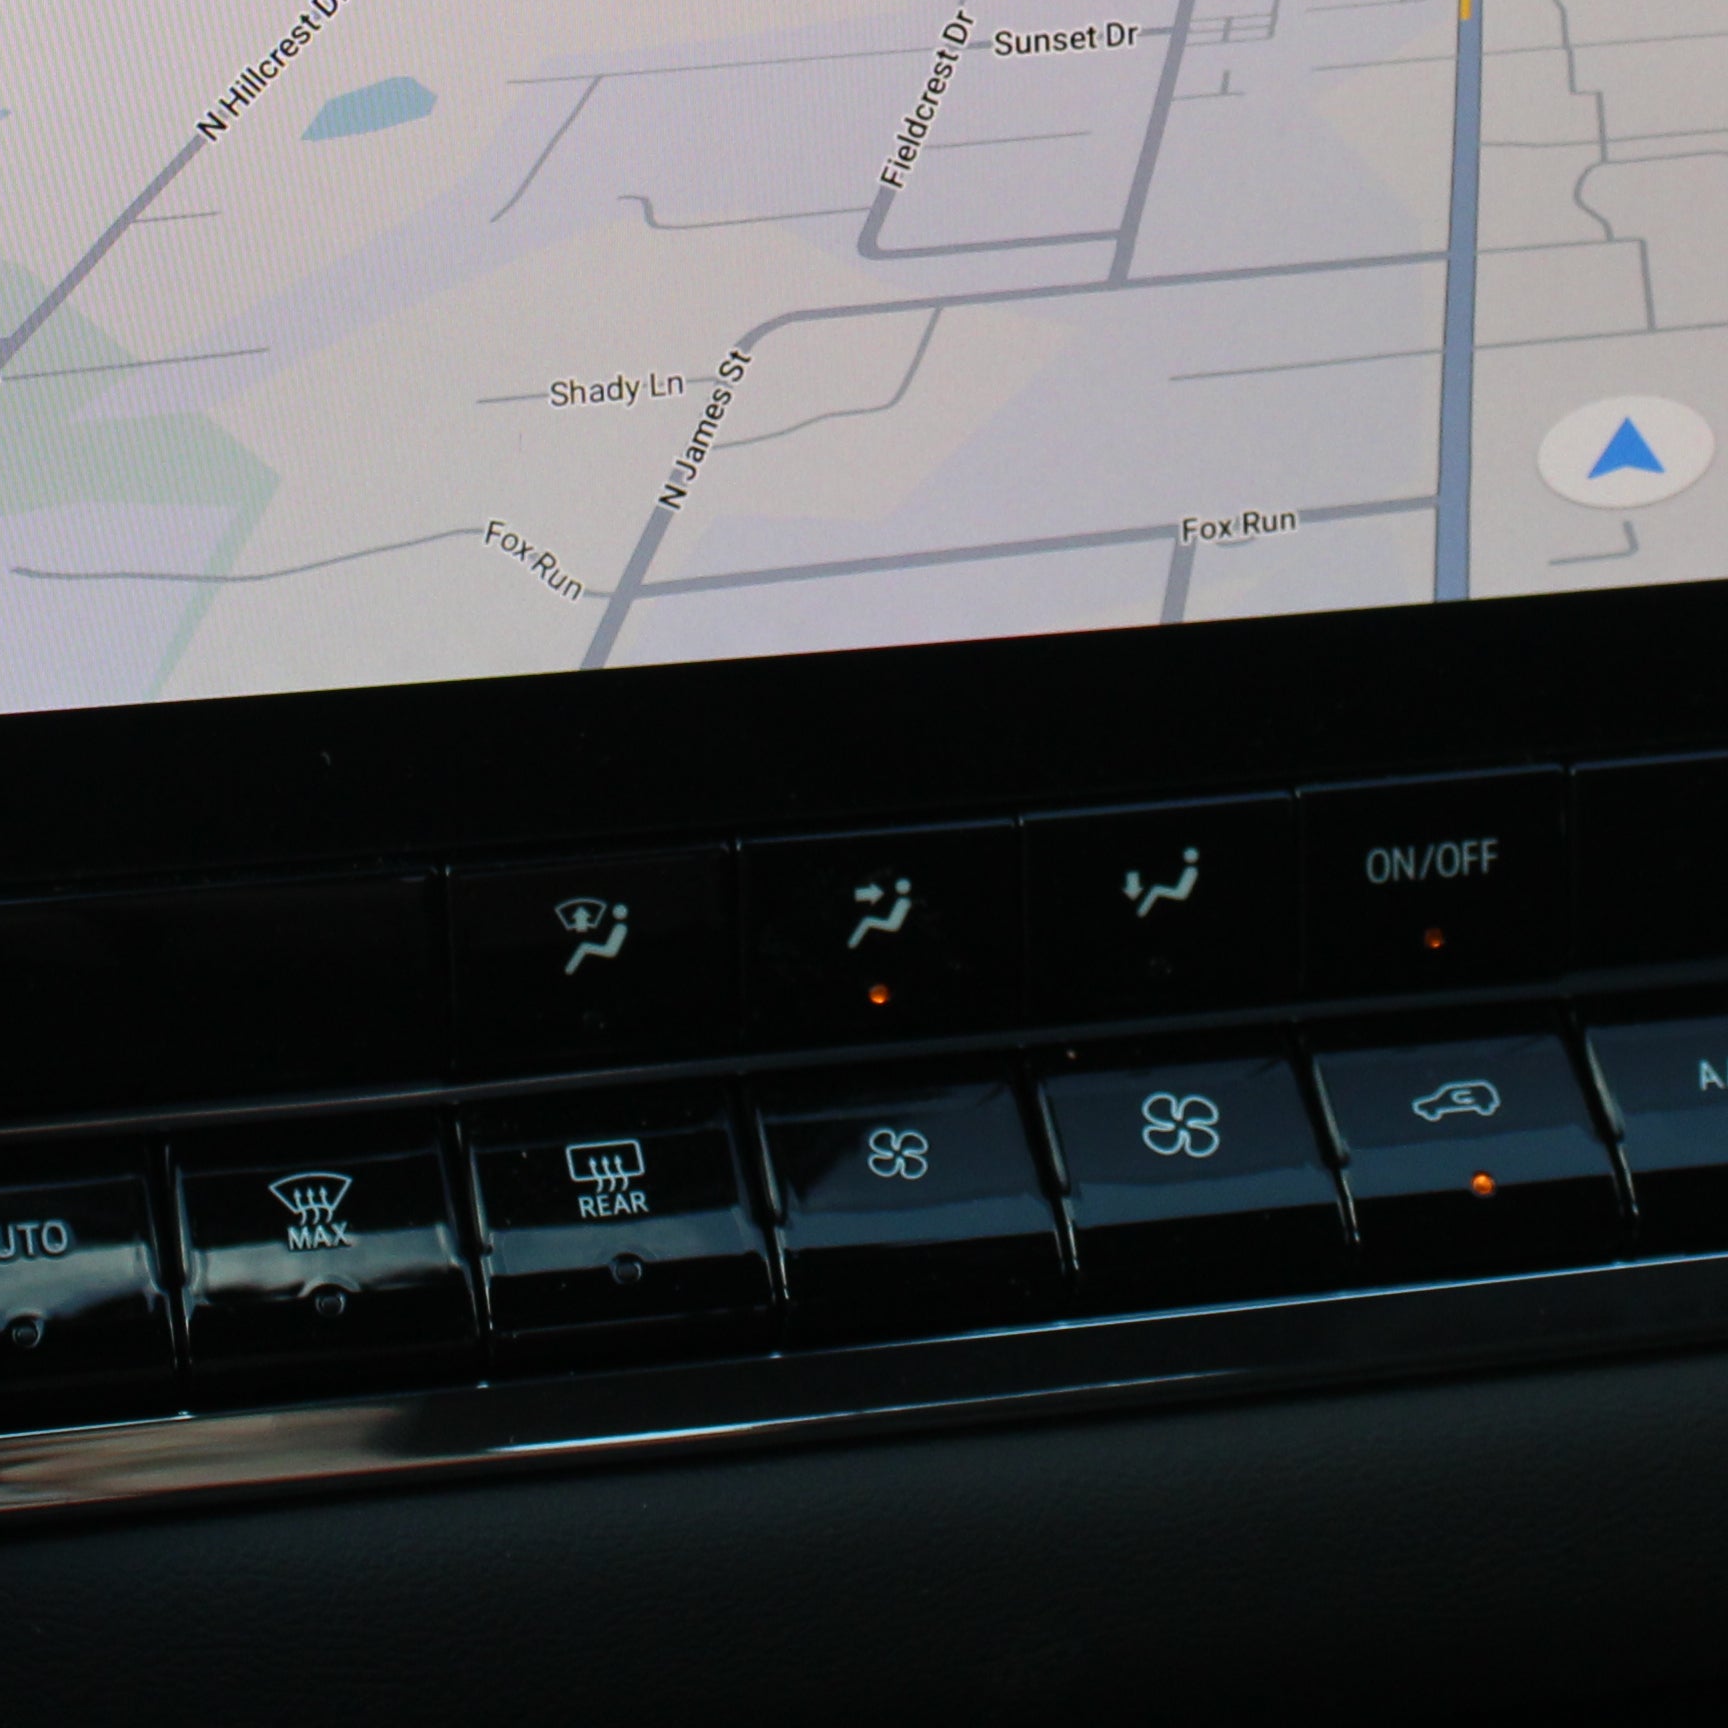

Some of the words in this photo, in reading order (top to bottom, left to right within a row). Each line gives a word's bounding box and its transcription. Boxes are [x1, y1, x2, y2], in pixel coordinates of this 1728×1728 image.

[993, 25, 1098, 56] Sunset
[1106, 21, 1139, 49] Dr
[197, 113, 227, 143] N
[218, 14, 325, 120] Hillcrest
[880, 46, 960, 190] Fieldcrest
[942, 10, 976, 47] Dr
[549, 374, 642, 408] Shady
[650, 372, 685, 397] Ln
[658, 483, 688, 511] N
[675, 386, 733, 481] James
[718, 349, 752, 383] St
[1181, 516, 1234, 543] Fox
[1241, 509, 1297, 536] Run
[483, 519, 535, 562] Fox
[530, 550, 584, 602] Run
[1365, 837, 1499, 885] ON/OFF
[577, 1190, 650, 1219] REAR
[287, 1220, 351, 1251] MAX
